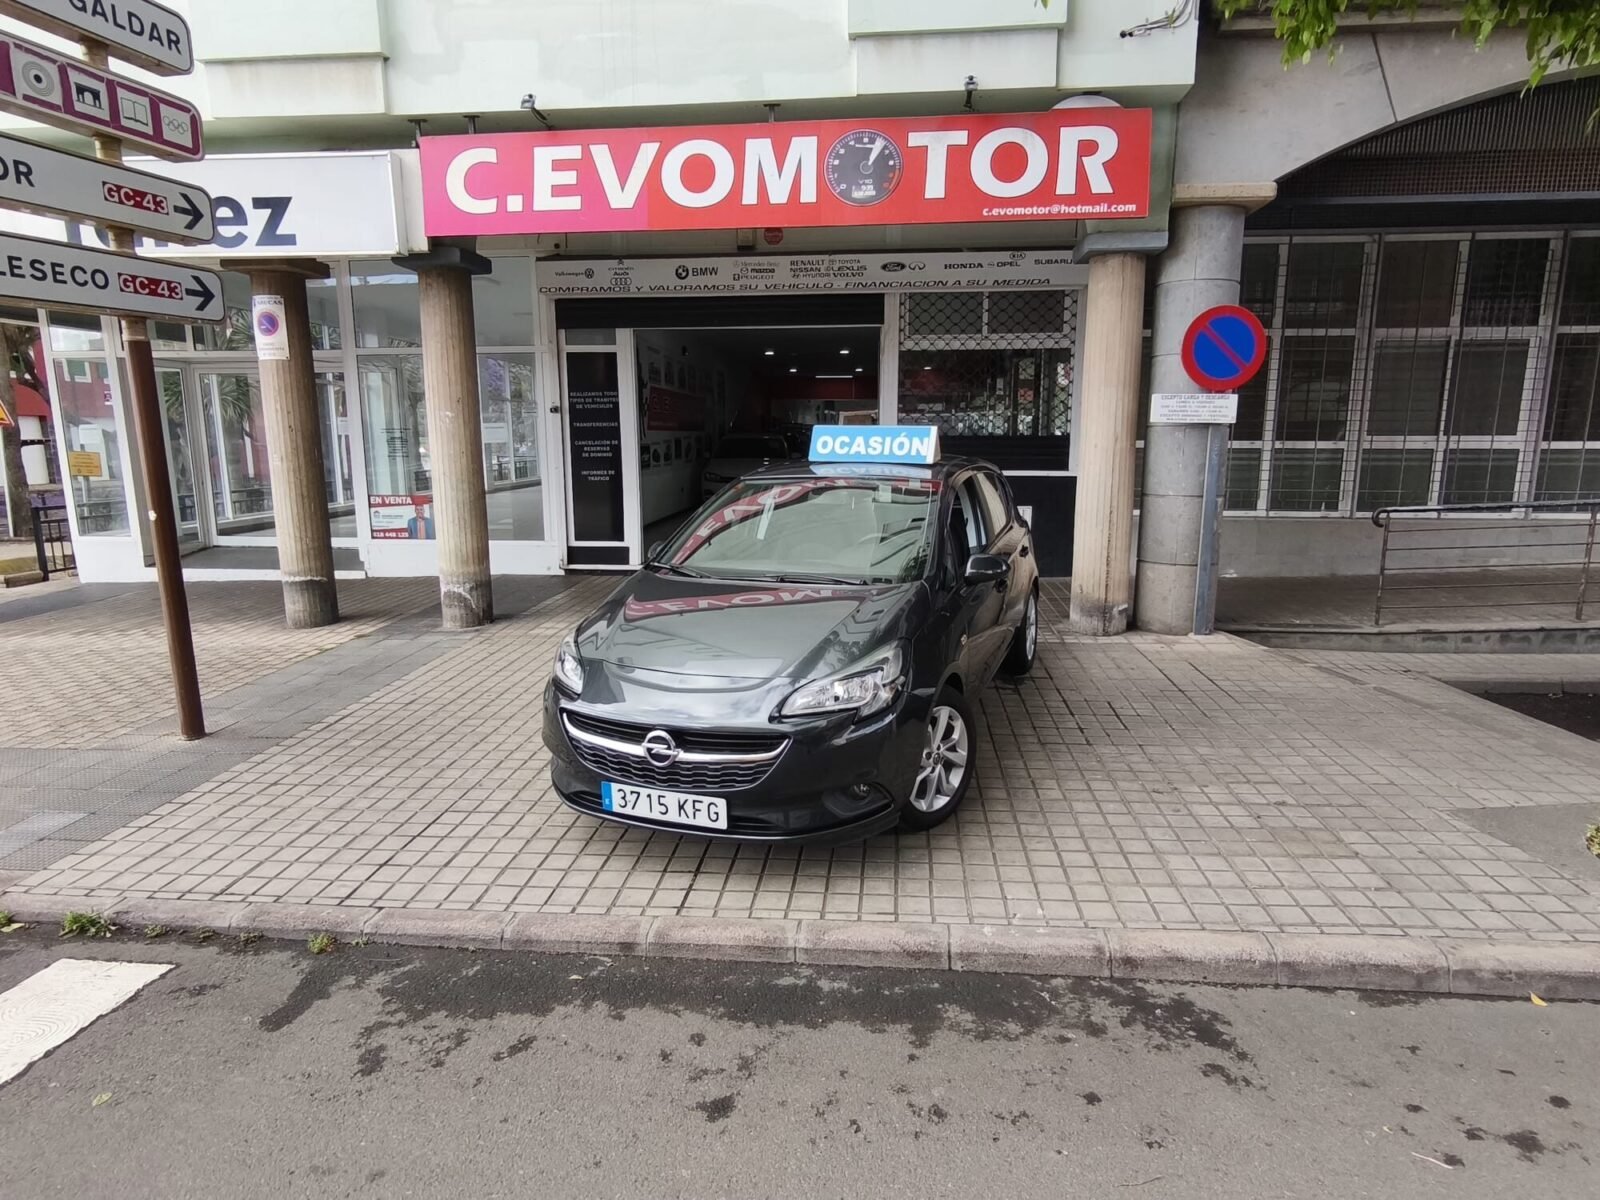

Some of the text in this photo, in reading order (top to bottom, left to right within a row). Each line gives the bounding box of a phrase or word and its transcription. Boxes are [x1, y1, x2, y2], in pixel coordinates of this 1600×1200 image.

[103, 183, 168, 215] GC-43
[982, 203, 1137, 217] c.evomotor@hotmail.com
[789, 259, 825, 267] RENAULT
[691, 267, 719, 277] BMW
[118, 274, 182, 300] GC-43
[539, 286, 631, 294] COMPRAMOS
[648, 284, 735, 292] VALORAMOS
[739, 283, 759, 291] SU
[765, 282, 834, 290] VEHICULO
[845, 280, 949, 290] FINANCIACION
[966, 279, 987, 287] SU
[992, 278, 1051, 286] MEDIDA
[816, 432, 930, 457] OCASIÓN
[370, 496, 412, 505] EN VENTA
[617, 789, 719, 823] 3715 KFG
